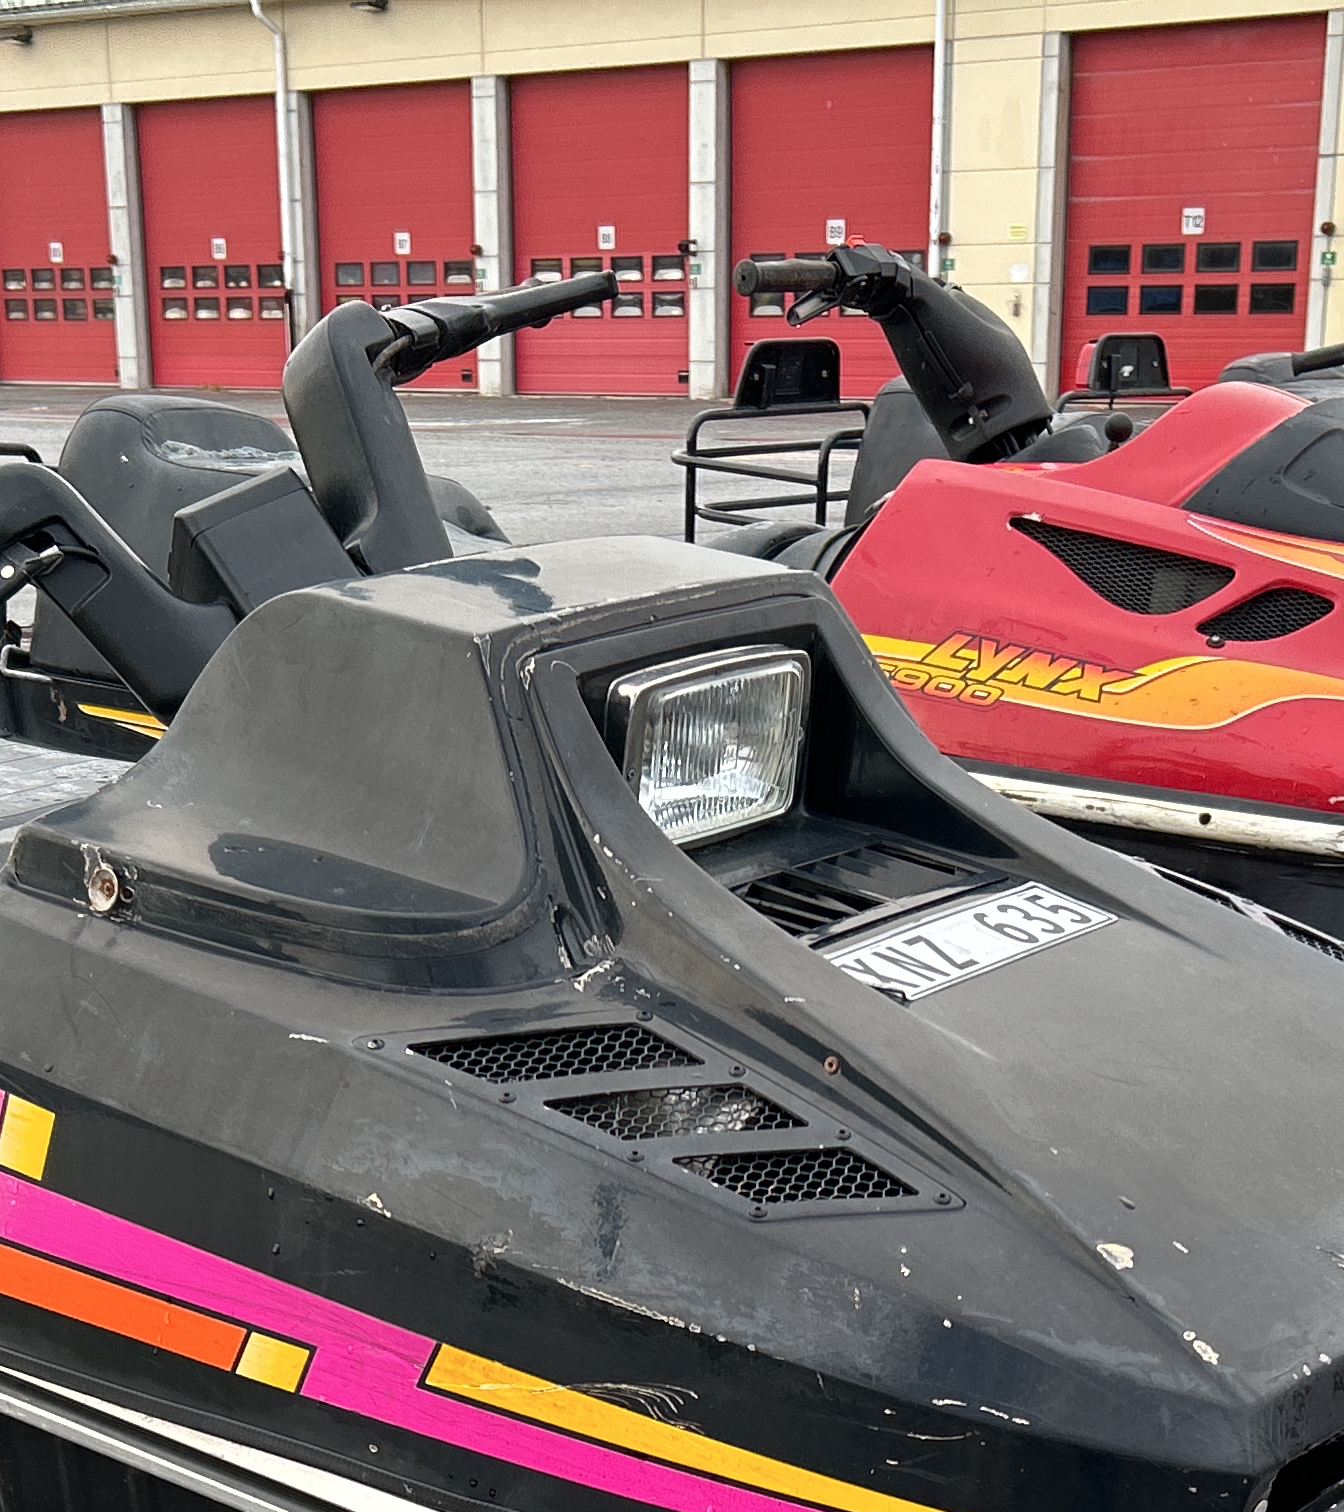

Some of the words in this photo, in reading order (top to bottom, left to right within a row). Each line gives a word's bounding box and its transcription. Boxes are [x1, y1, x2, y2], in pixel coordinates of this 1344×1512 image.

[878, 662, 1005, 707] 900
[921, 629, 1148, 703] LYNX
[840, 935, 979, 989] XNZ
[973, 894, 1093, 945] 635
